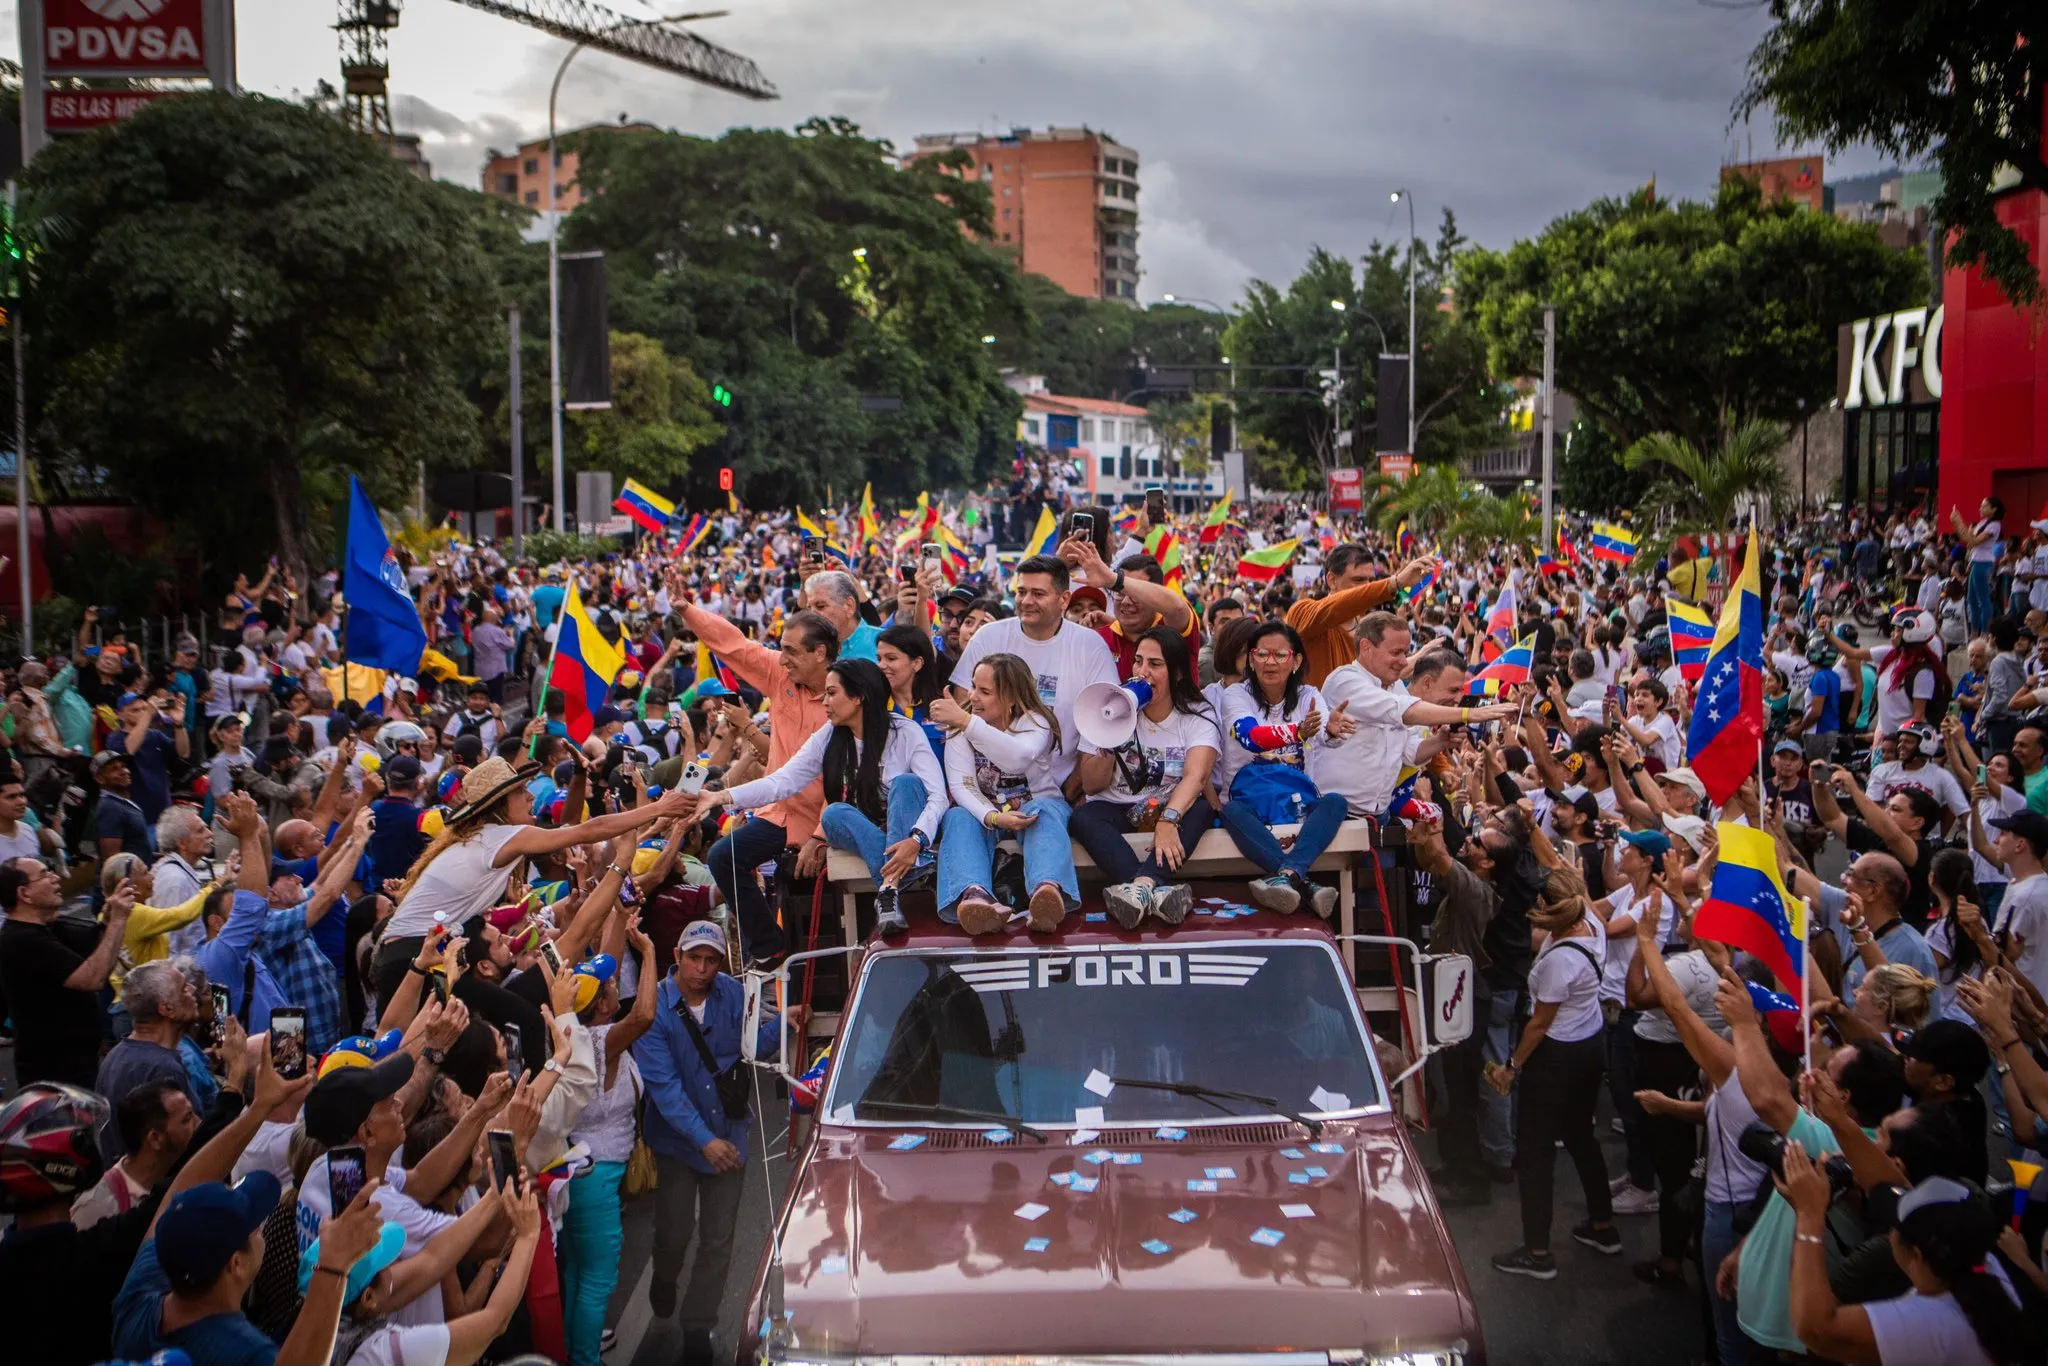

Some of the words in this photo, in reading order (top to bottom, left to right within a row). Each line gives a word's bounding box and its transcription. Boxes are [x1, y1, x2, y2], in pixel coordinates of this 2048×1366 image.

[47, 26, 201, 60] PDVSA
[79, 97, 113, 119] LAS
[1038, 954, 1182, 988] FORD
